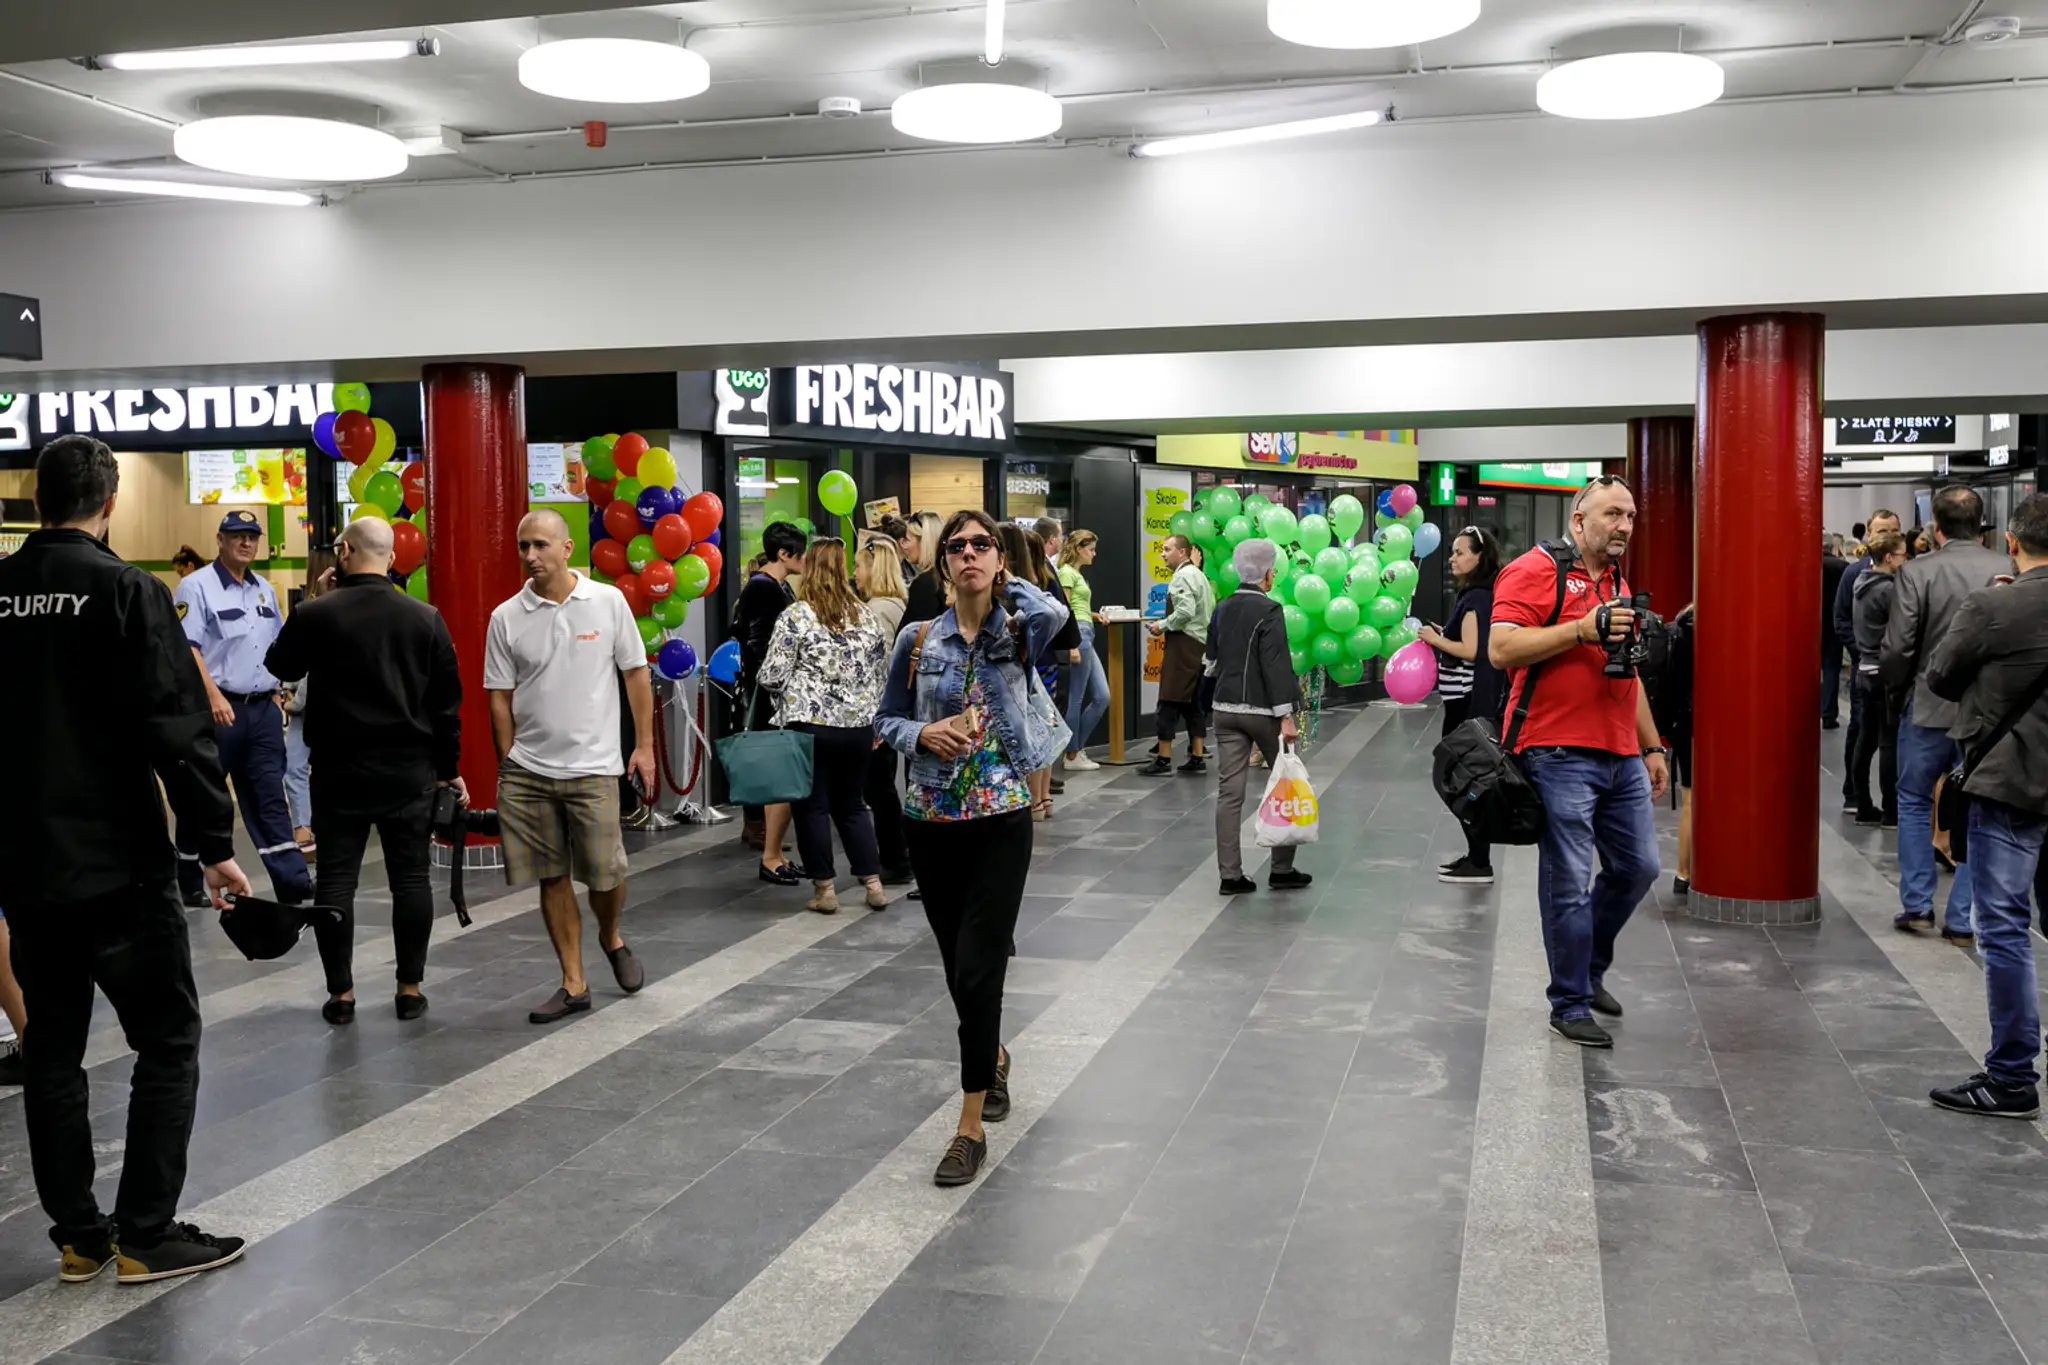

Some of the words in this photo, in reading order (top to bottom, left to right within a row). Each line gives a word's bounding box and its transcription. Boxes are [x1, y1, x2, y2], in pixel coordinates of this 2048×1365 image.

[730, 369, 765, 390] UGO
[796, 363, 1006, 440] FRESHBAR
[1852, 415, 1890, 428] ZLATÉ
[1894, 416, 1940, 428] PIESKY
[1156, 489, 1177, 505] Škola
[1146, 517, 1170, 530] Kance
[1566, 579, 1587, 594] 89
[1269, 796, 1315, 817] teta
